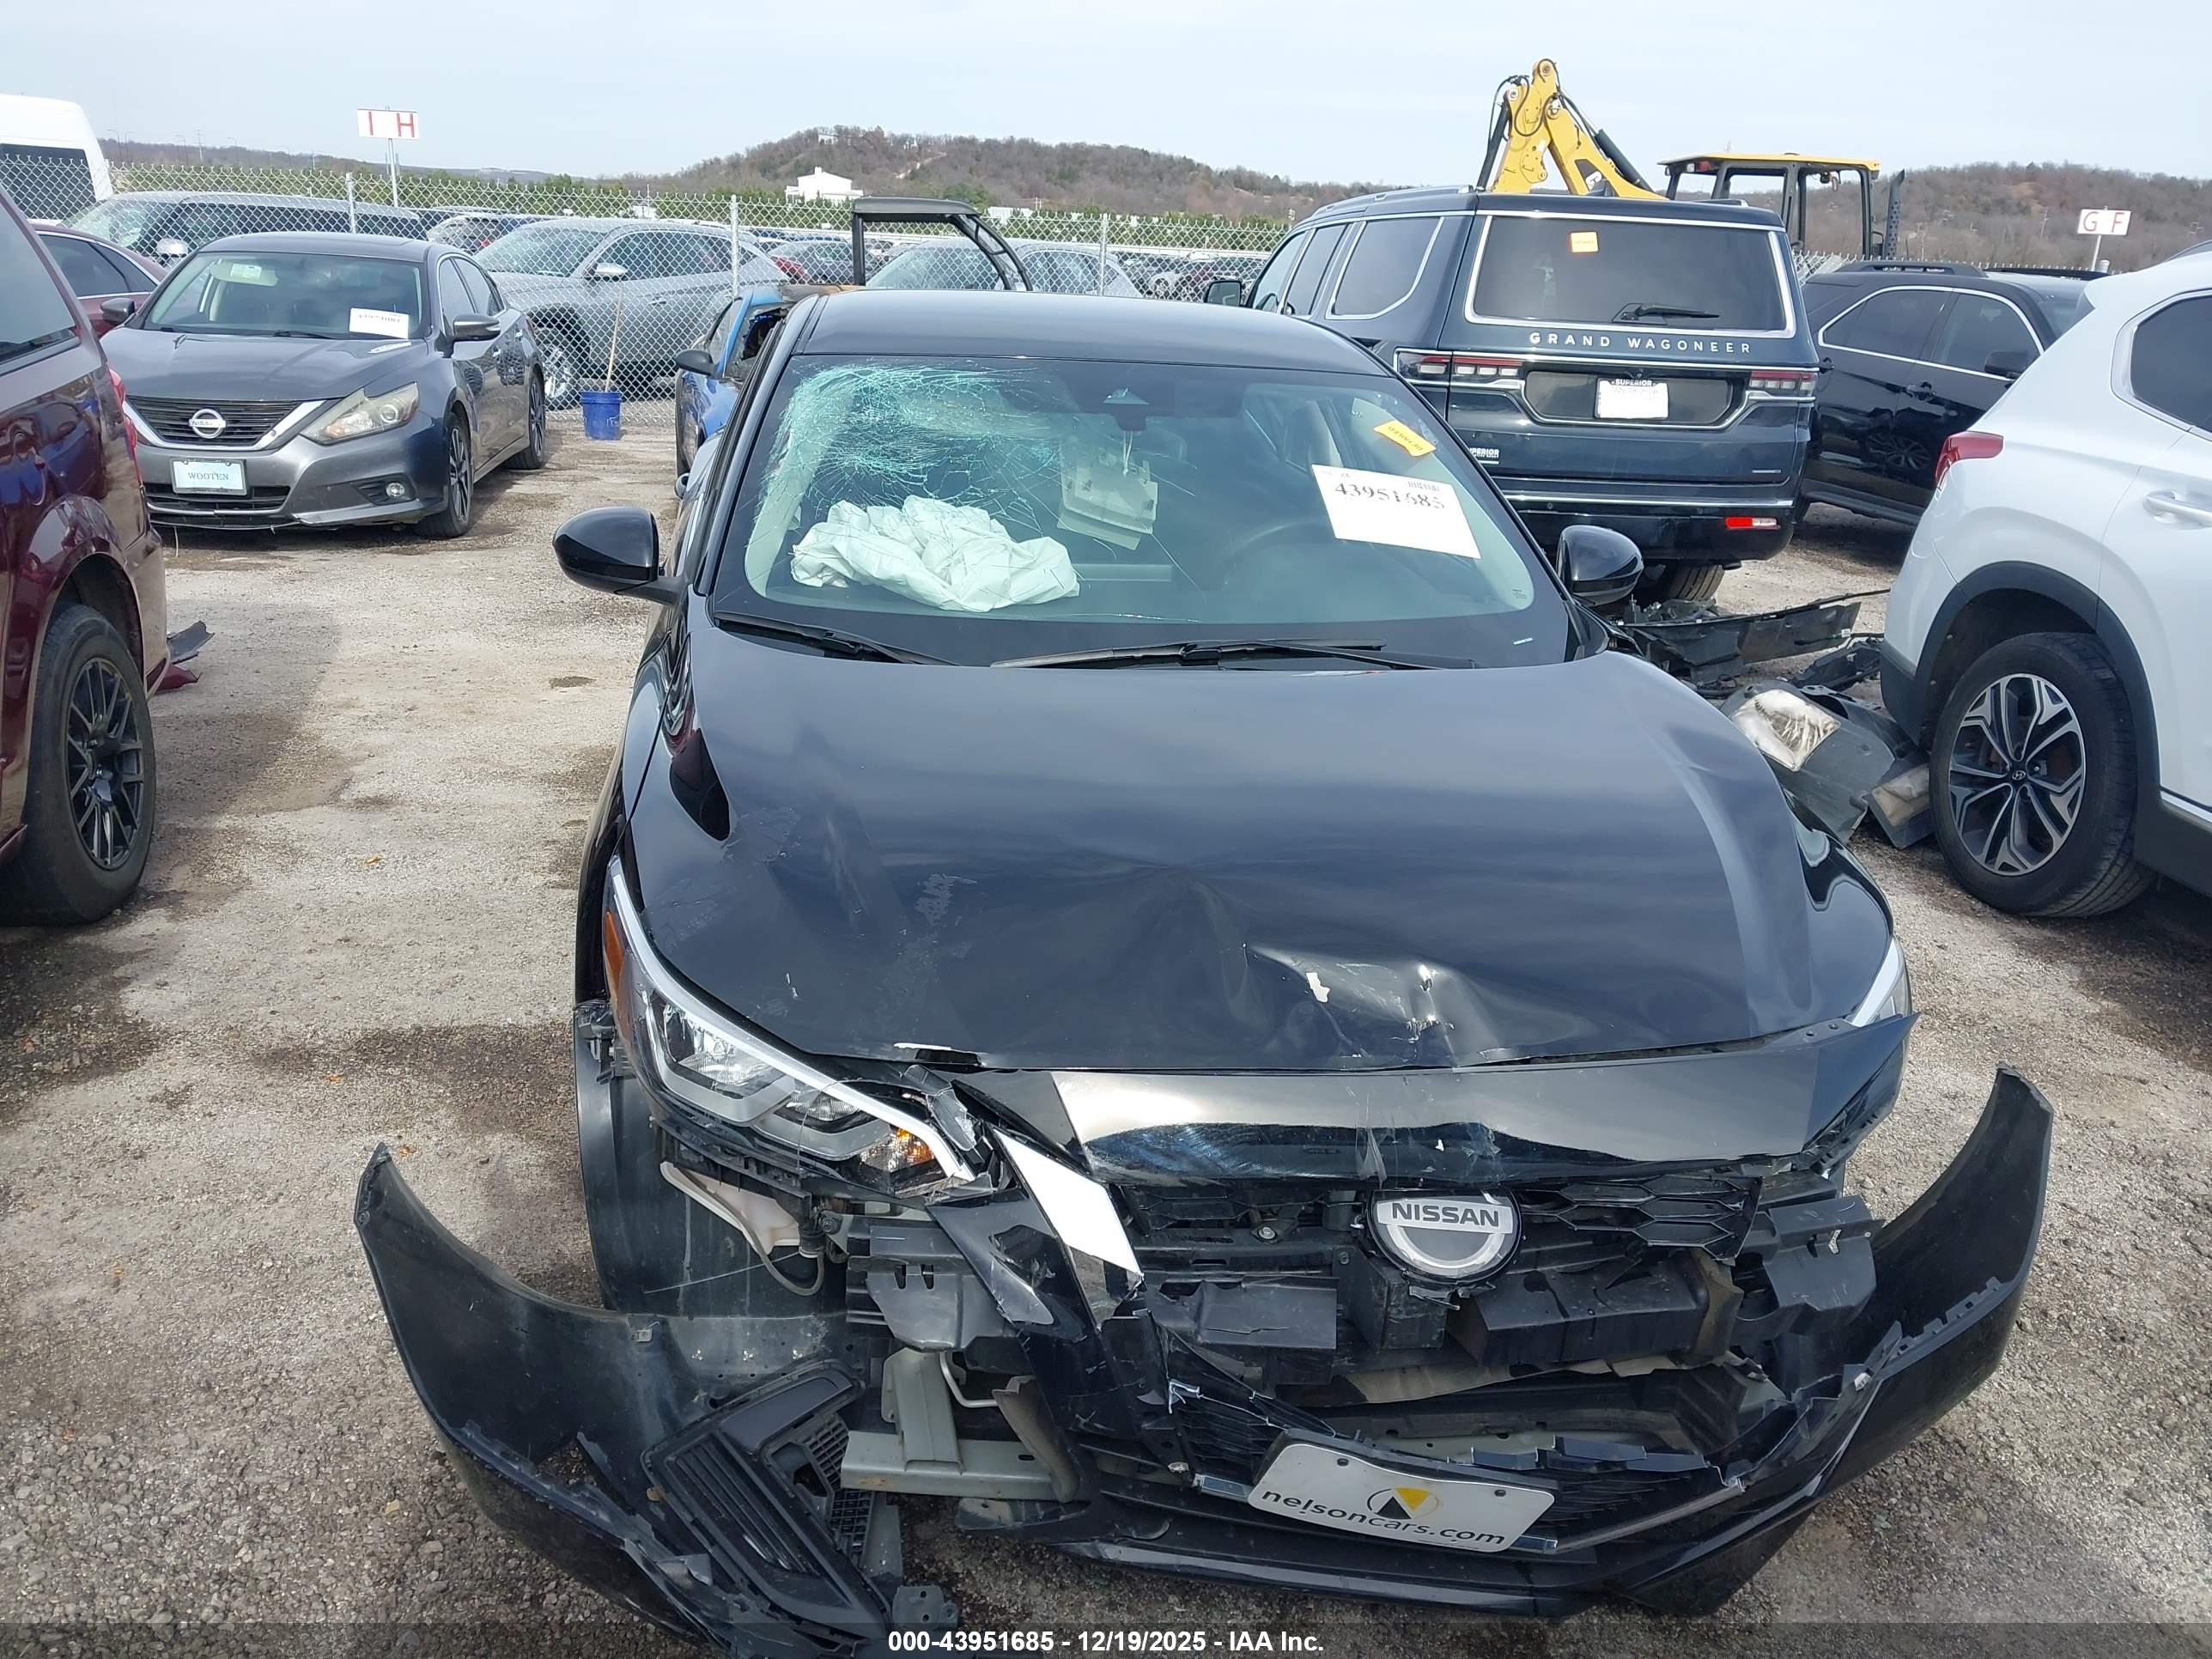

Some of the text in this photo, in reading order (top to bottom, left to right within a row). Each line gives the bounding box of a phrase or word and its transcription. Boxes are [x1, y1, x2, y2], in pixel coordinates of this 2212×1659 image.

[396, 112, 415, 137] H
[2083, 211, 2125, 233] G F
[1529, 332, 1751, 354] GRAND WAGONEER
[187, 471, 229, 481] WOOTEN
[1392, 1203, 1499, 1227] NISSAN
[1261, 1489, 1505, 1545] nelsoncars.com
